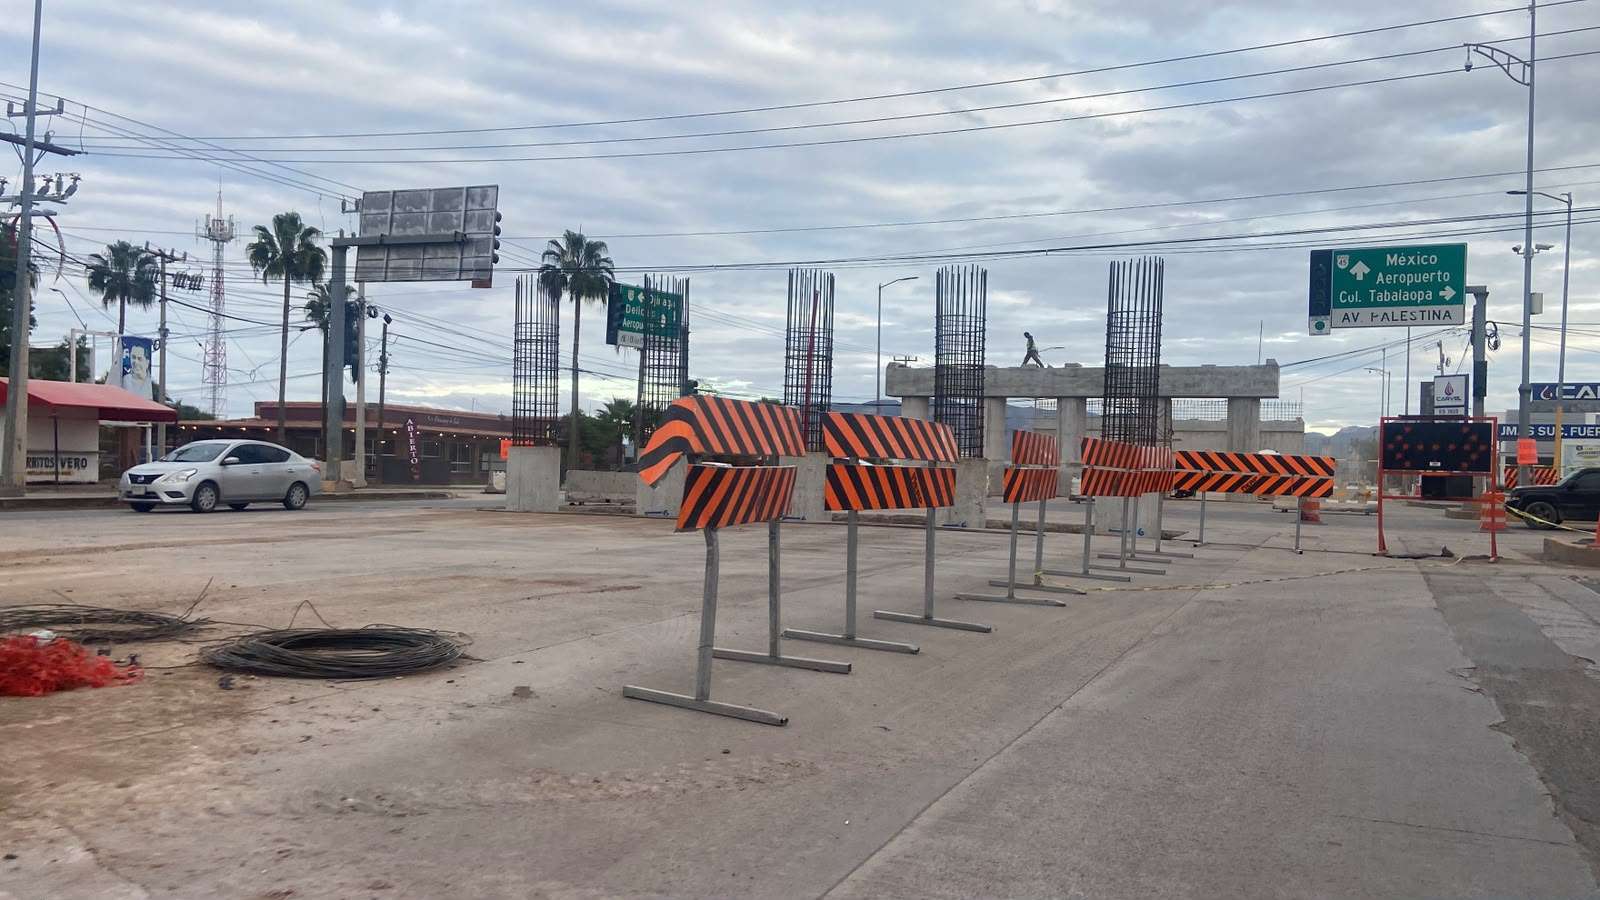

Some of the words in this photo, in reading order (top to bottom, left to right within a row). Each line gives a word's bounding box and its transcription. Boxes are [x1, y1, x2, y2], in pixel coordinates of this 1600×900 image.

[1386, 252, 1438, 267] México
[1376, 271, 1450, 286] Aeropuerto
[1339, 290, 1362, 304] Col.
[1369, 288, 1433, 304] Tabalaopa
[1500, 426, 1535, 436] JMS
[406, 418, 418, 464] ABIERTO
[60, 456, 88, 471] VERO
